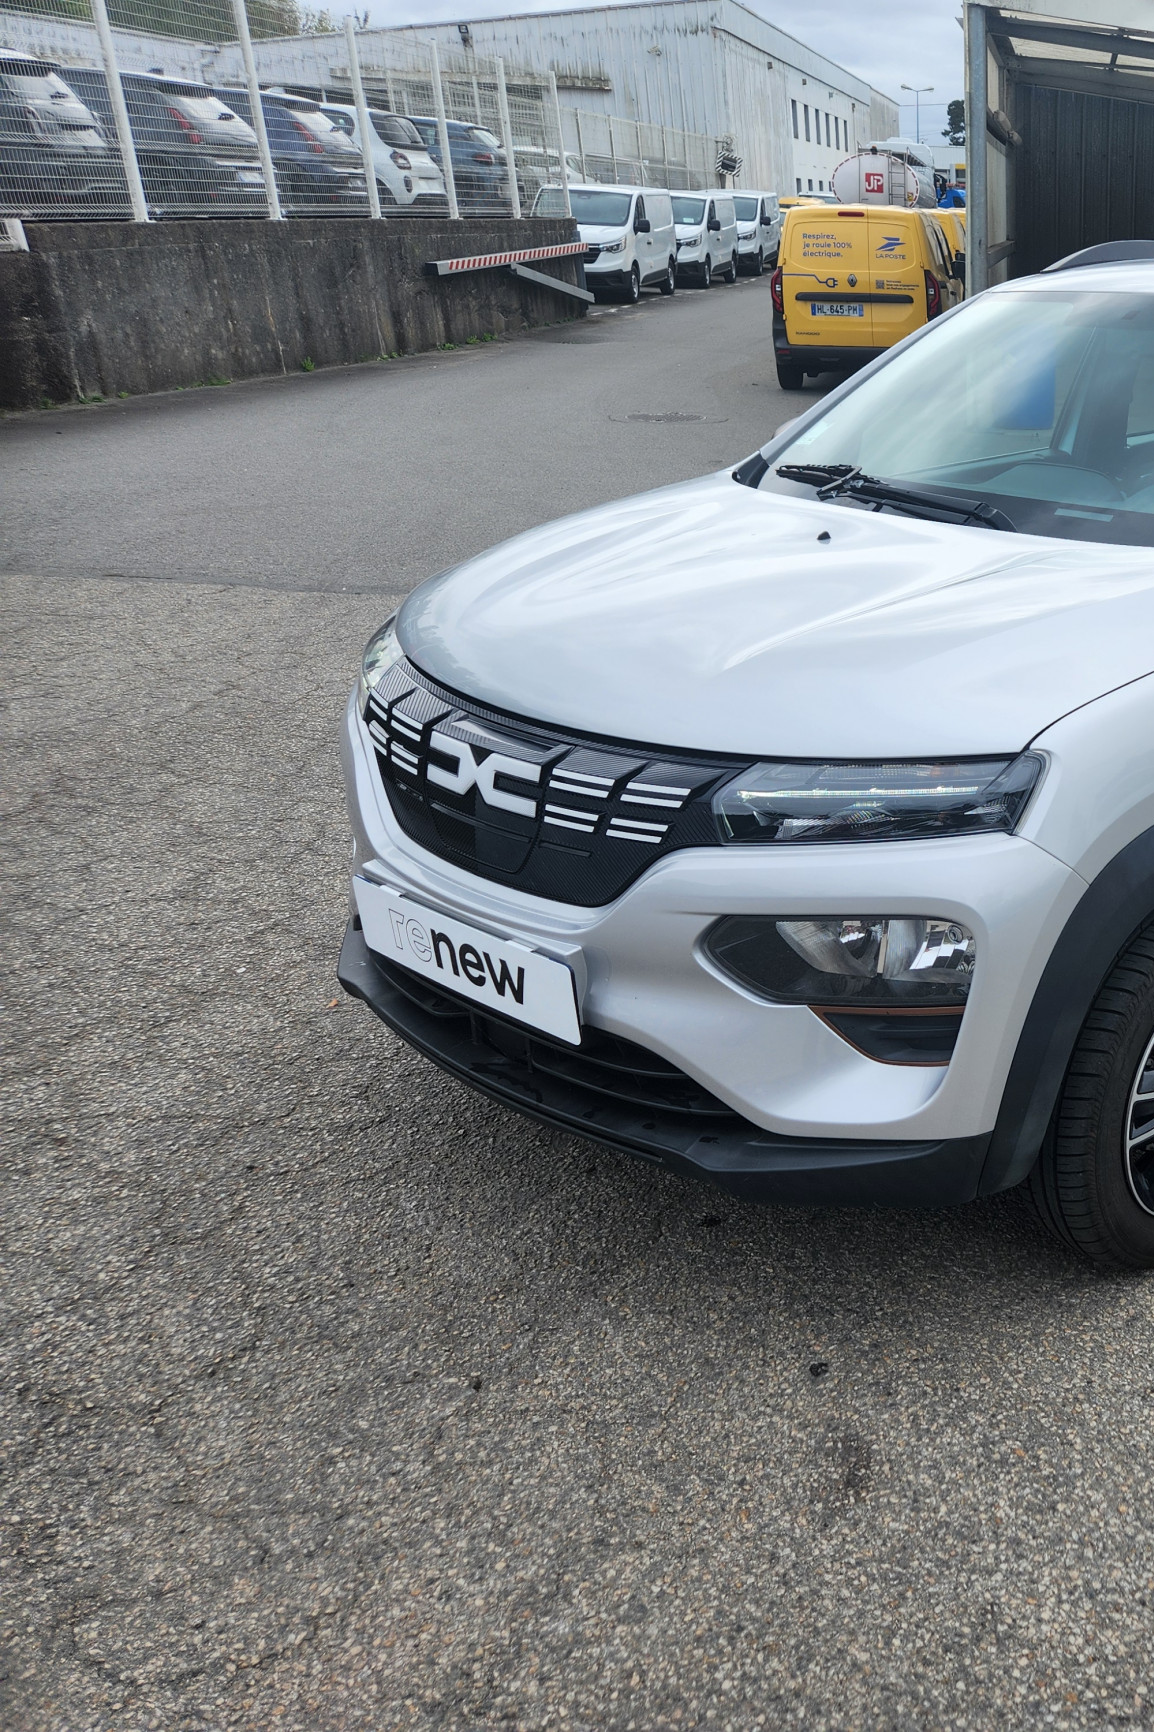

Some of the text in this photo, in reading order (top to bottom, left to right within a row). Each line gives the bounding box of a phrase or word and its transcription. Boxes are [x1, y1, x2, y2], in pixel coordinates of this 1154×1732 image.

[802, 232, 836, 241] Respirez,
[803, 241, 852, 250] je roule 100%
[802, 249, 843, 259] électrique.
[388, 908, 525, 1005] renew
